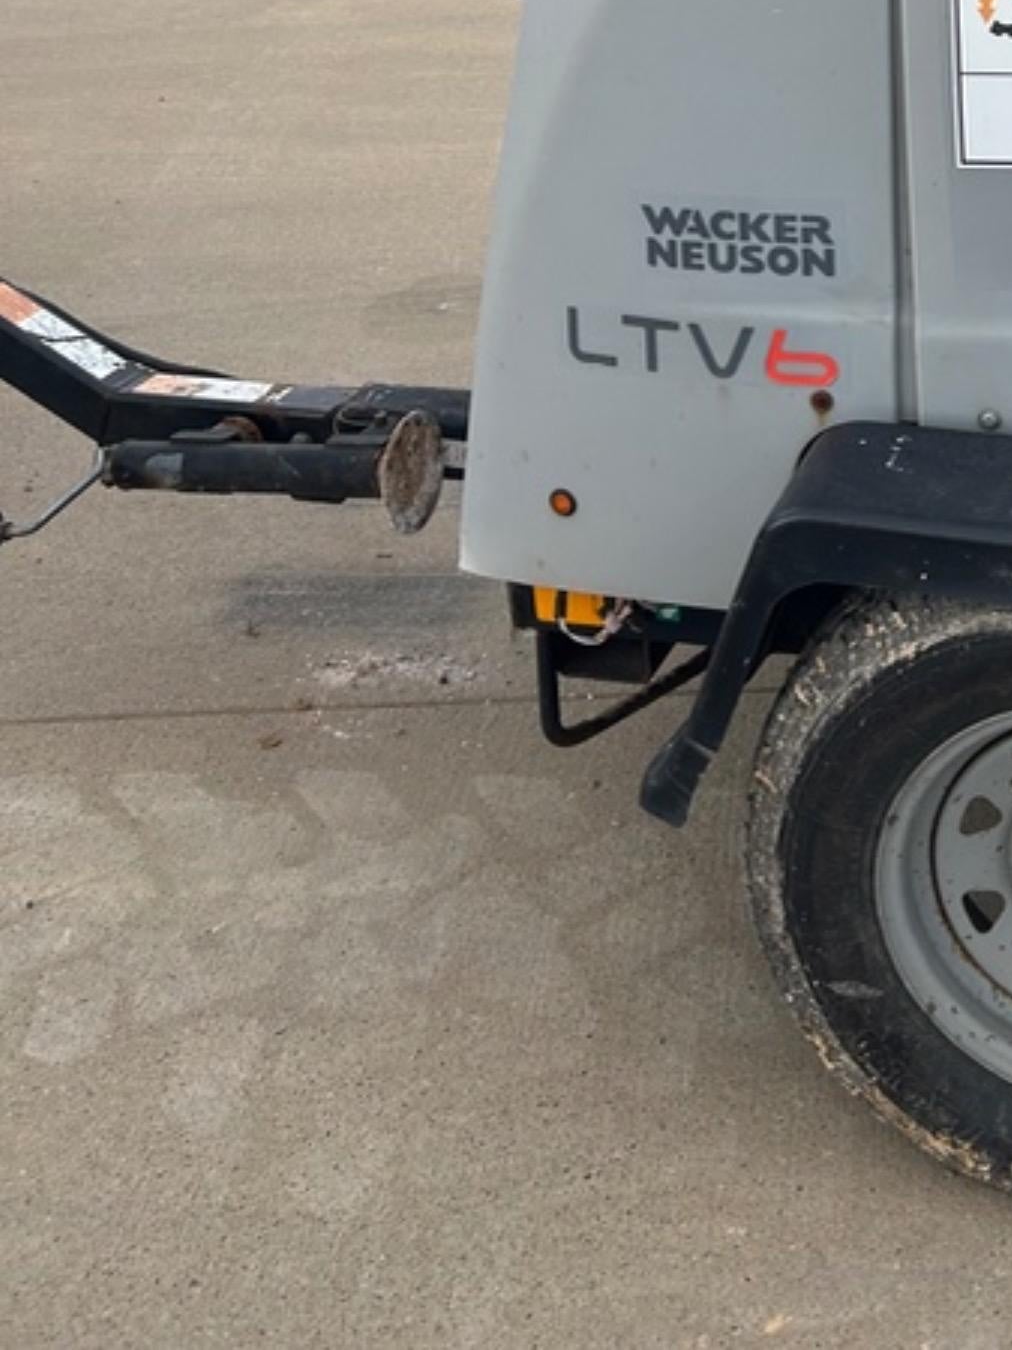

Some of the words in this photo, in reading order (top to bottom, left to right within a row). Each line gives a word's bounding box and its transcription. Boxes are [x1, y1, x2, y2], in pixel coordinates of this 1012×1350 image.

[641, 204, 834, 246] WACKER
[646, 237, 836, 277] NEUSON
[567, 305, 840, 387] LTV6
